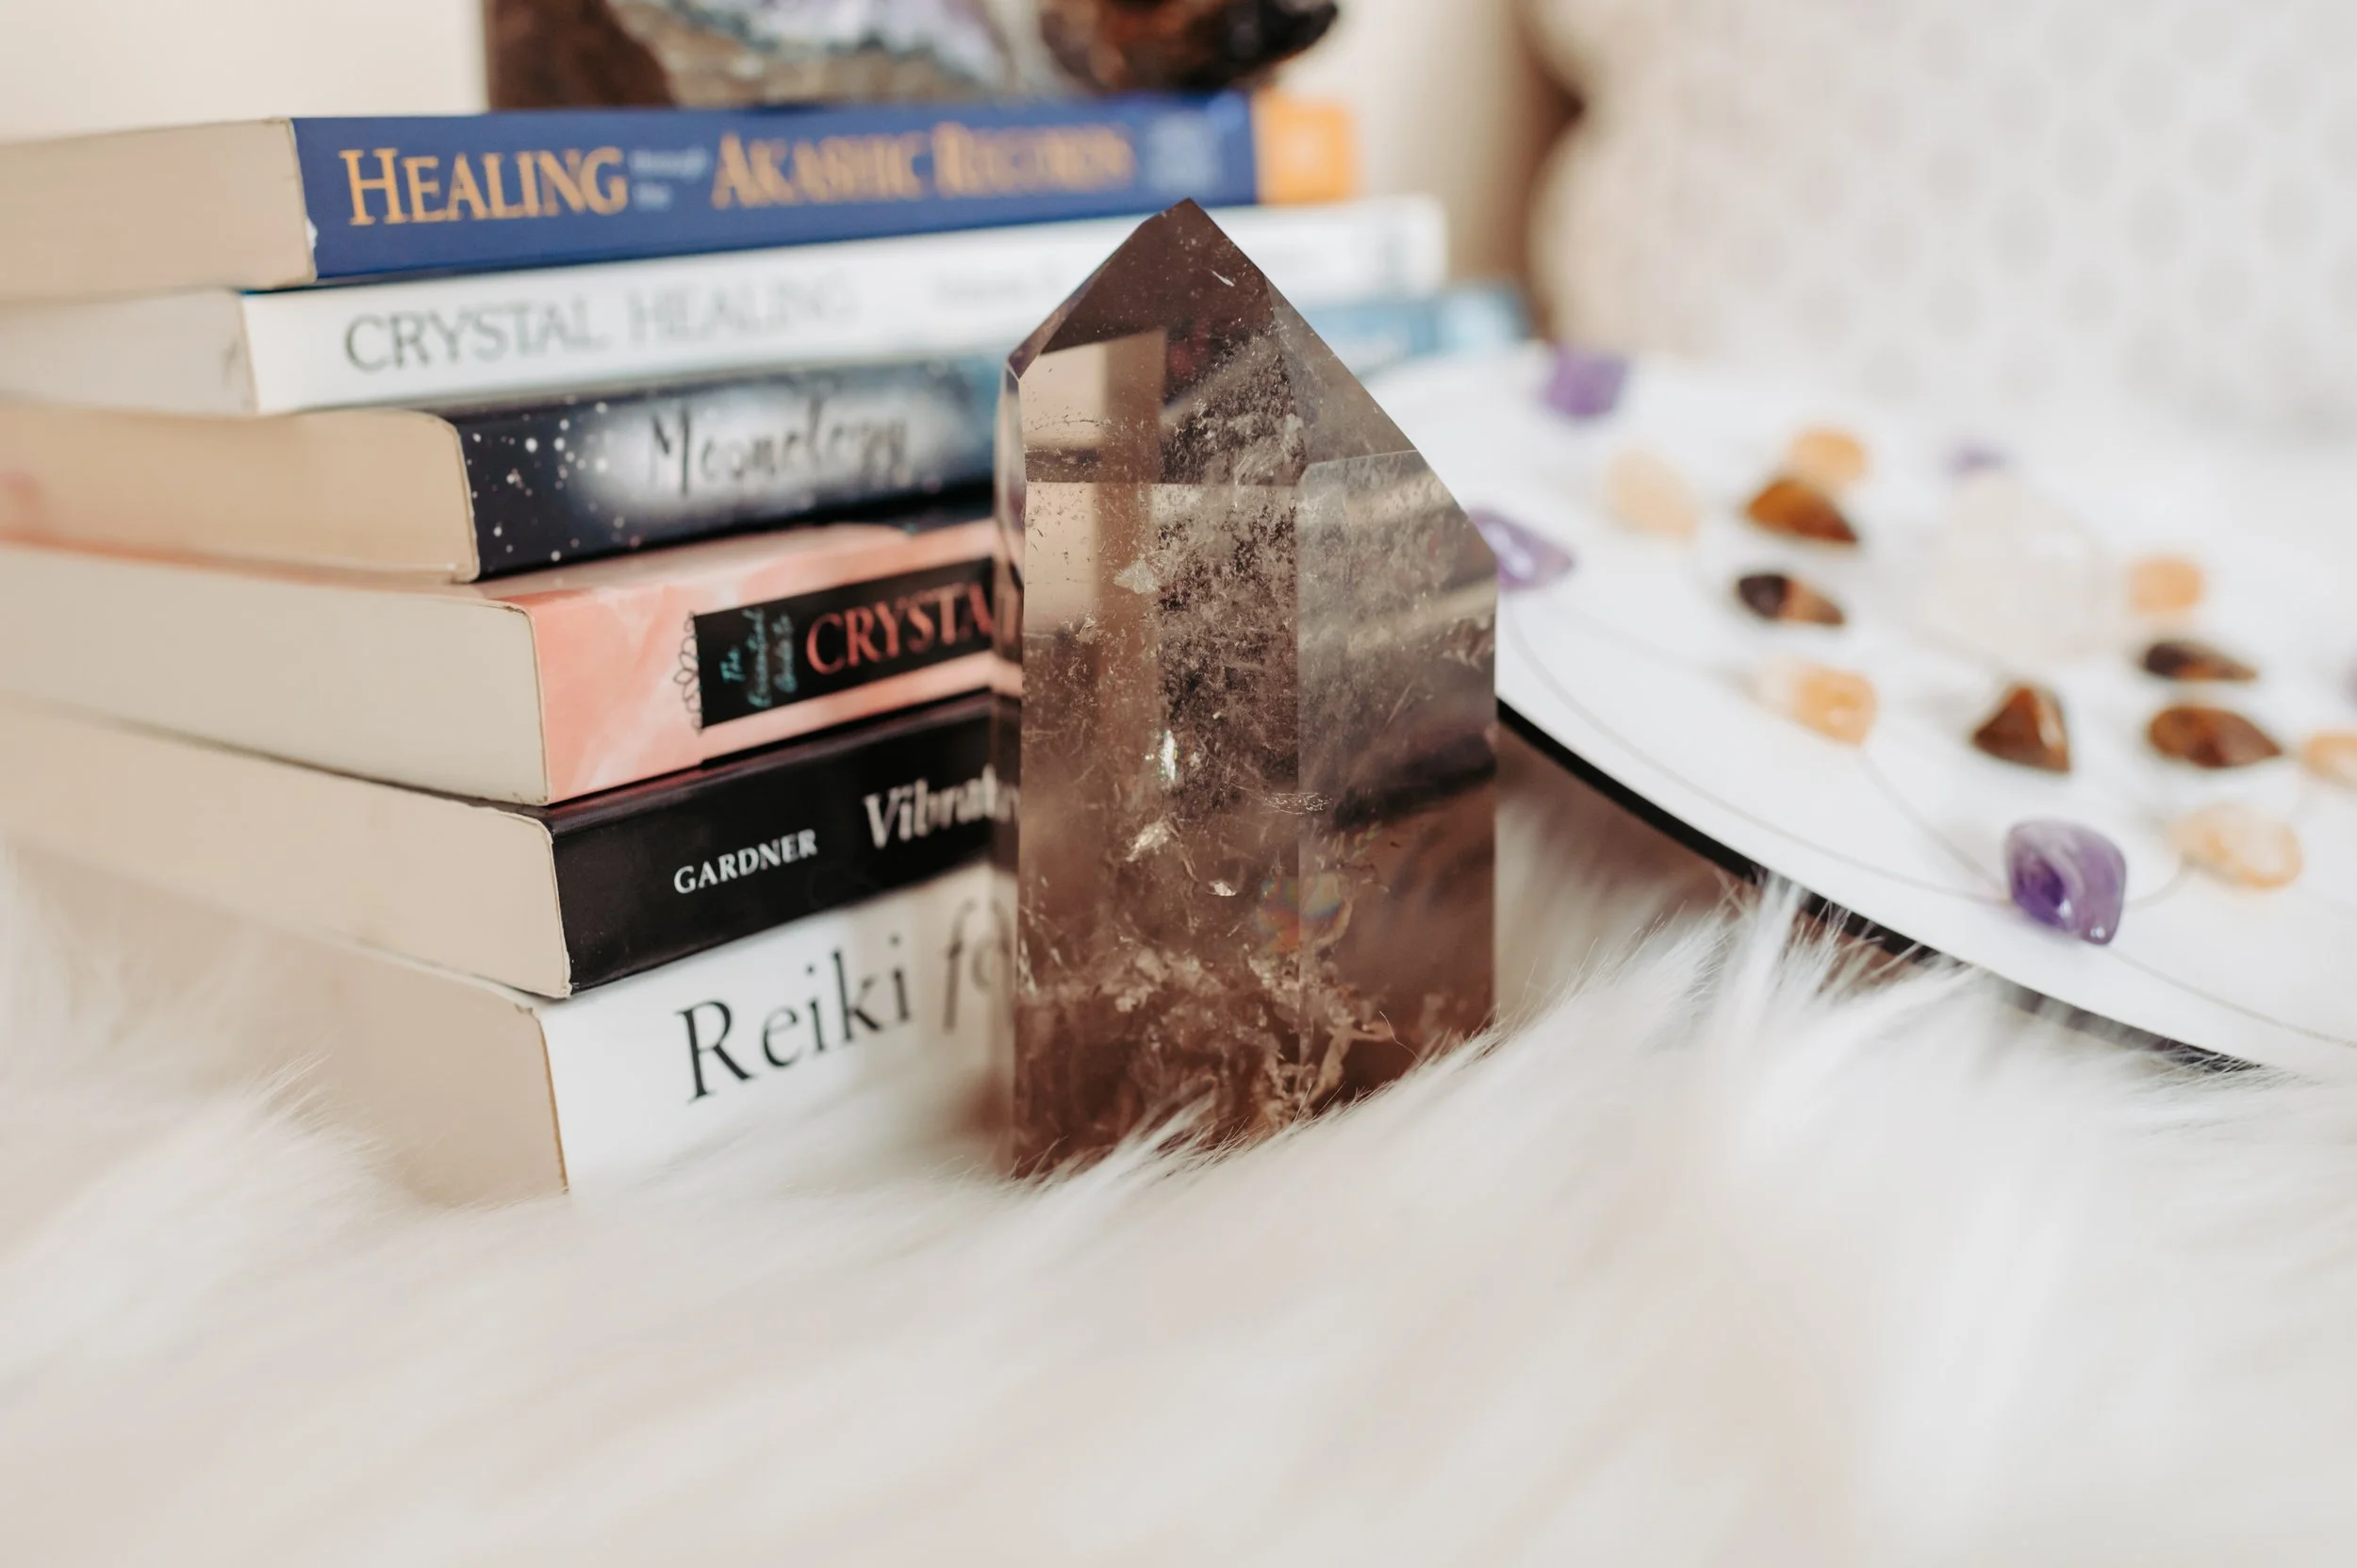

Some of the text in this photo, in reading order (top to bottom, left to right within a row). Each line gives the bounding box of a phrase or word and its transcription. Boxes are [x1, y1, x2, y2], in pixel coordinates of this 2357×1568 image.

[339, 147, 629, 225] HEALING
[345, 291, 608, 372] CRYSTAL
[806, 581, 995, 675] CRYSTA
[673, 829, 817, 893] GARDNER
[674, 932, 913, 1103] Reiki
